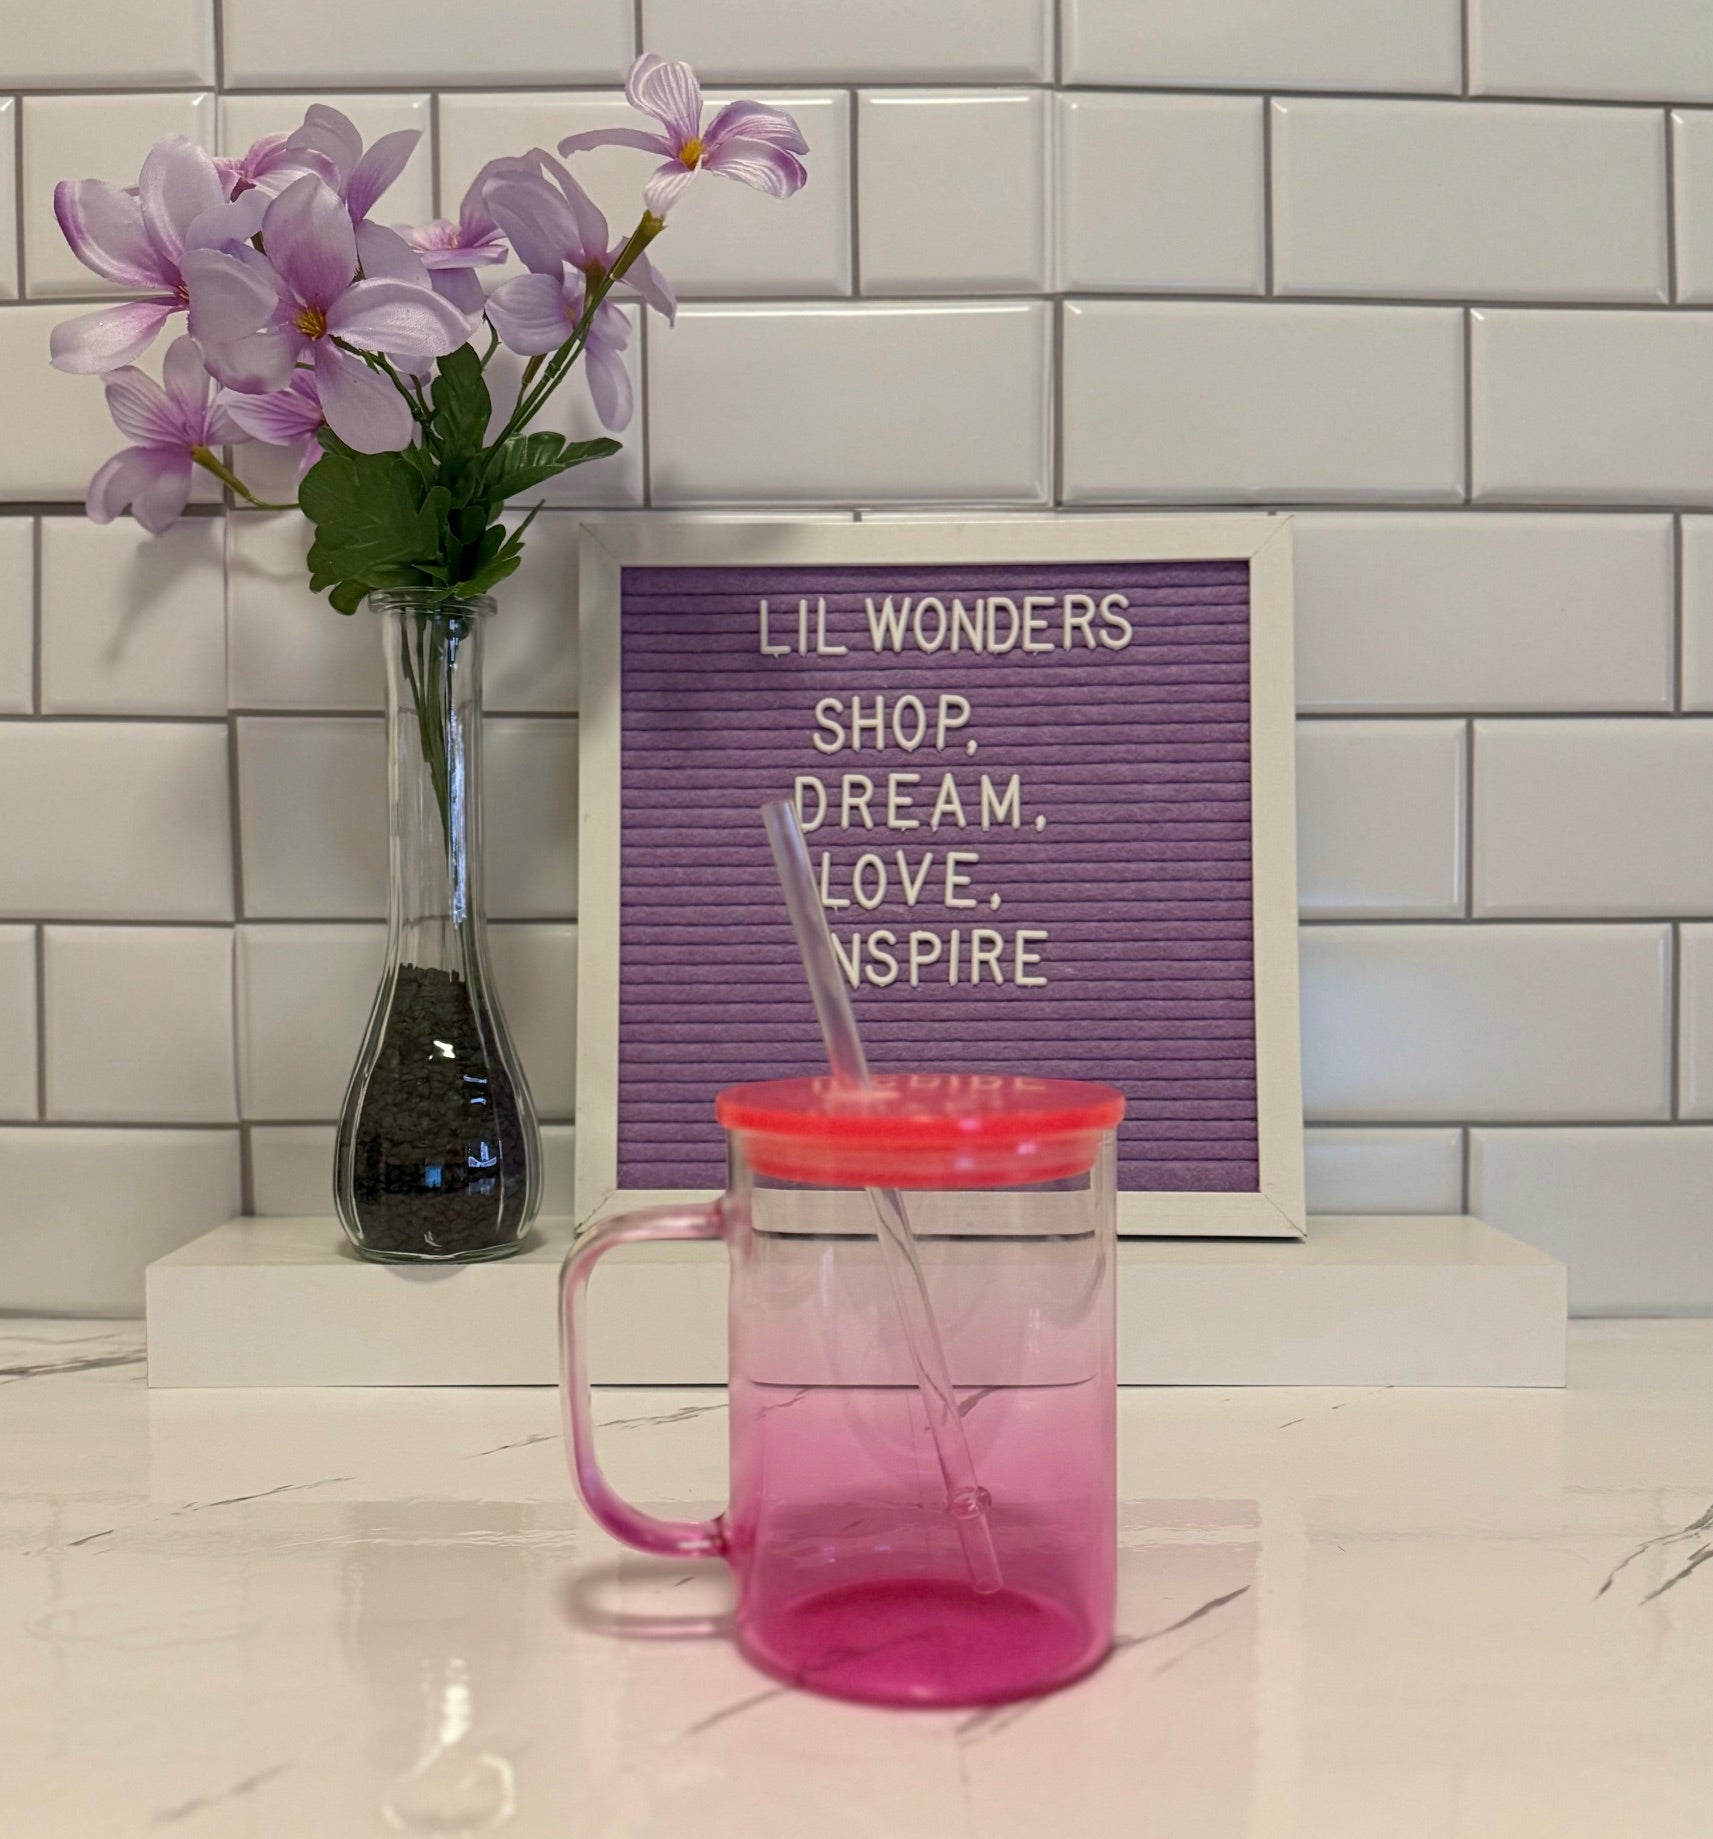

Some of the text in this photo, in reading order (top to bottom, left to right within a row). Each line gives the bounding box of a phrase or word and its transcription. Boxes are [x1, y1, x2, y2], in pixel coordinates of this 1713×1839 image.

[759, 594, 1133, 656] LIL WONDERS
[812, 694, 978, 754] SHOP,
[795, 773, 1047, 832] DREAM,
[819, 849, 1001, 911] LOVE,
[830, 928, 1049, 990] NSPIRE
